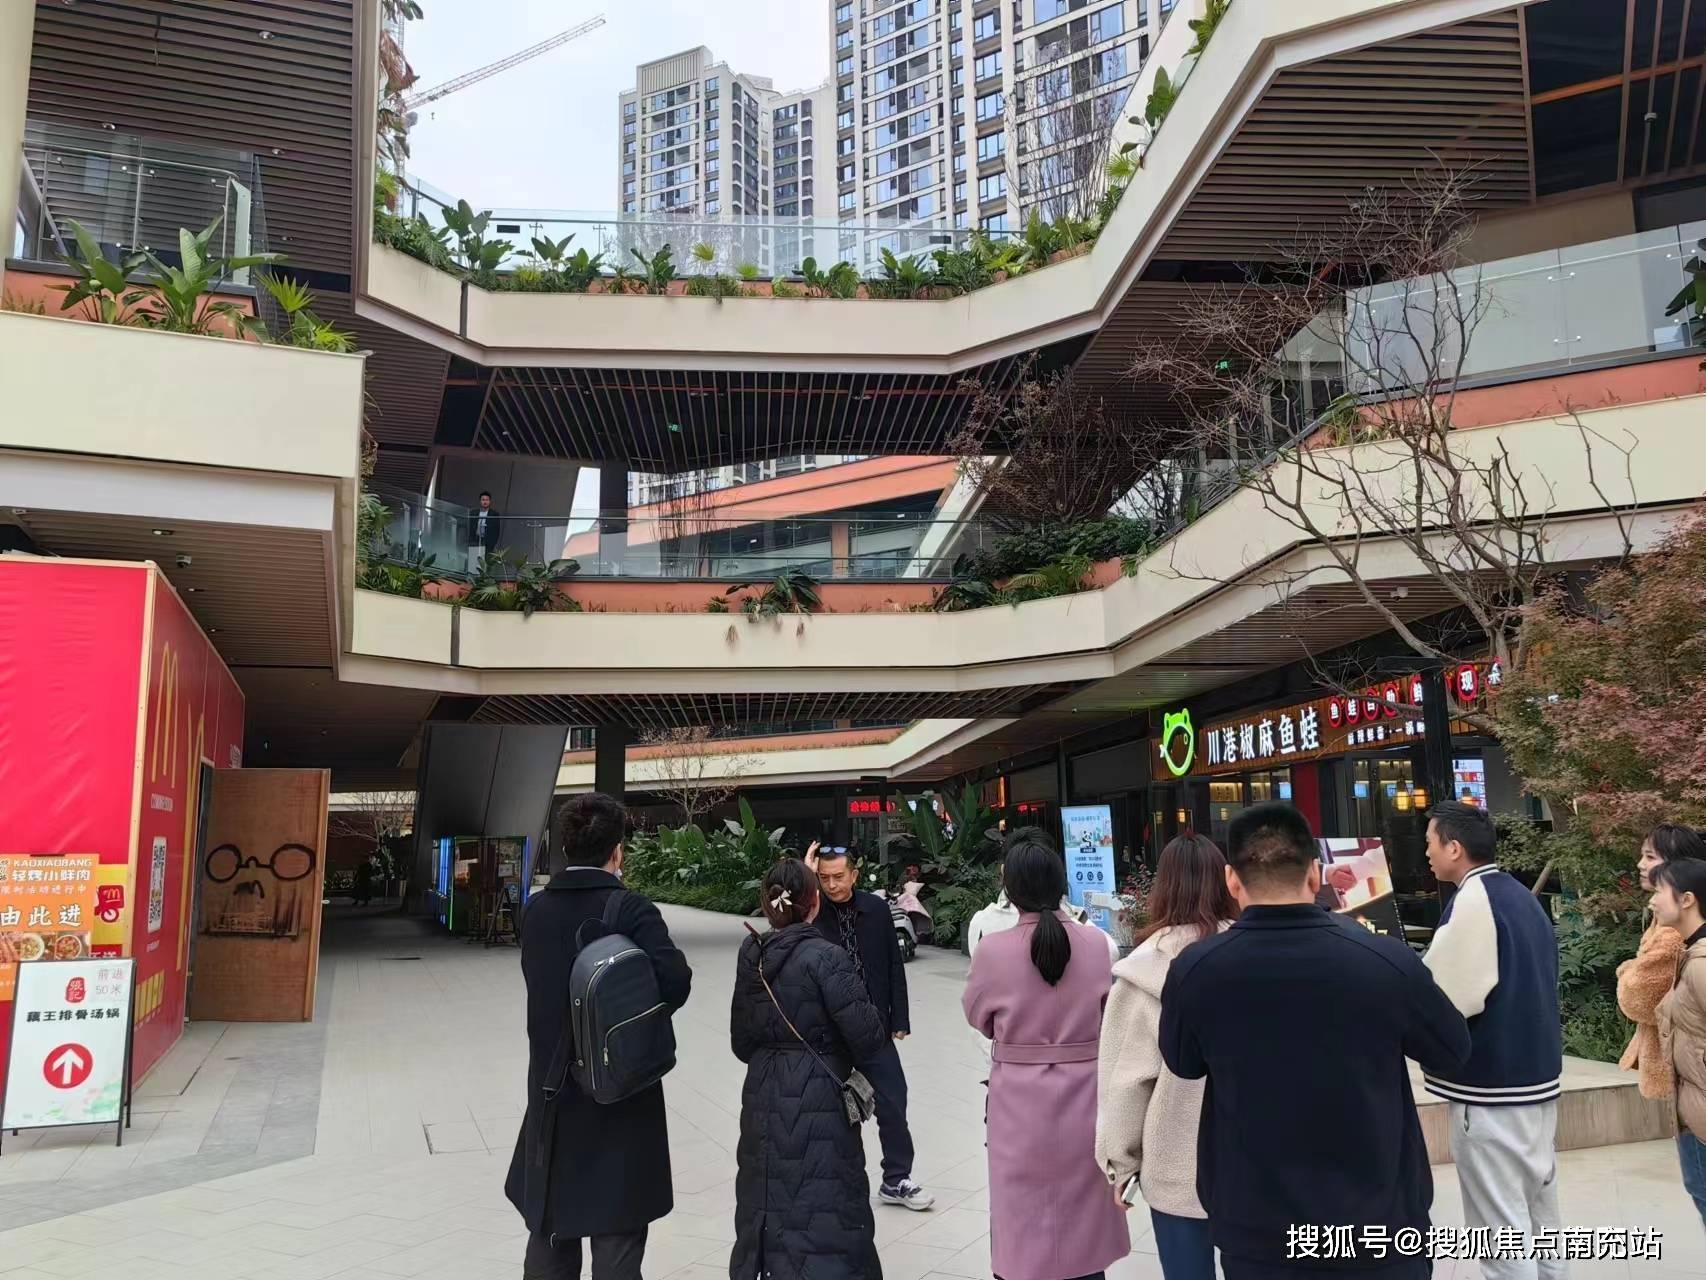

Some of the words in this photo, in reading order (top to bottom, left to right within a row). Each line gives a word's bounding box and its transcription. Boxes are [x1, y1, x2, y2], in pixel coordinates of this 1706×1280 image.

[1207, 706, 1320, 766] 川港椒麻鱼蛙
[13, 859, 92, 867] KAOXIAOBANG
[0, 904, 81, 927] 由此进
